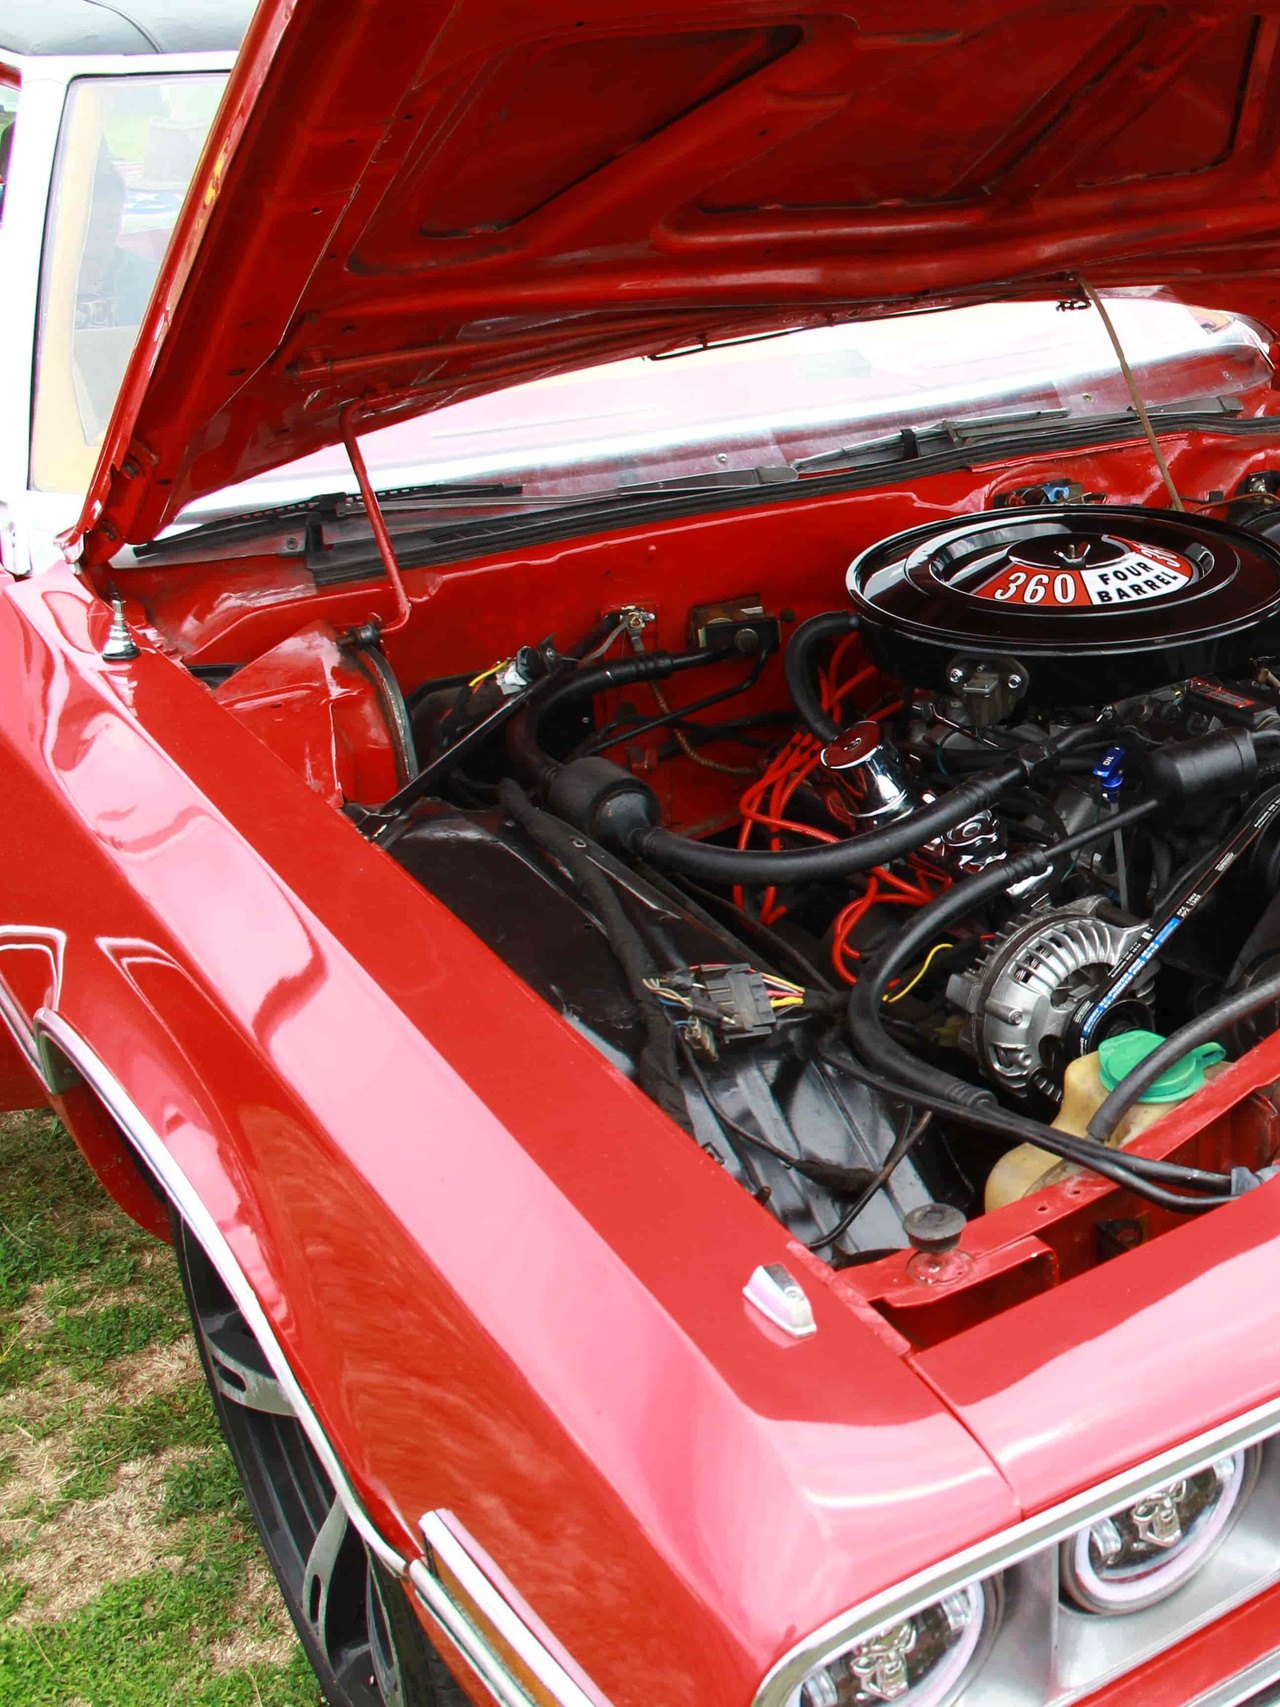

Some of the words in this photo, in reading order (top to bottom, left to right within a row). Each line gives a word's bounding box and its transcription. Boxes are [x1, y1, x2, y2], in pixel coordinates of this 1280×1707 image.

[993, 571, 1077, 604] 360
[1096, 571, 1180, 603] BARREL
[1097, 561, 1154, 586] FOUR
[1102, 756, 1115, 766] OIL
